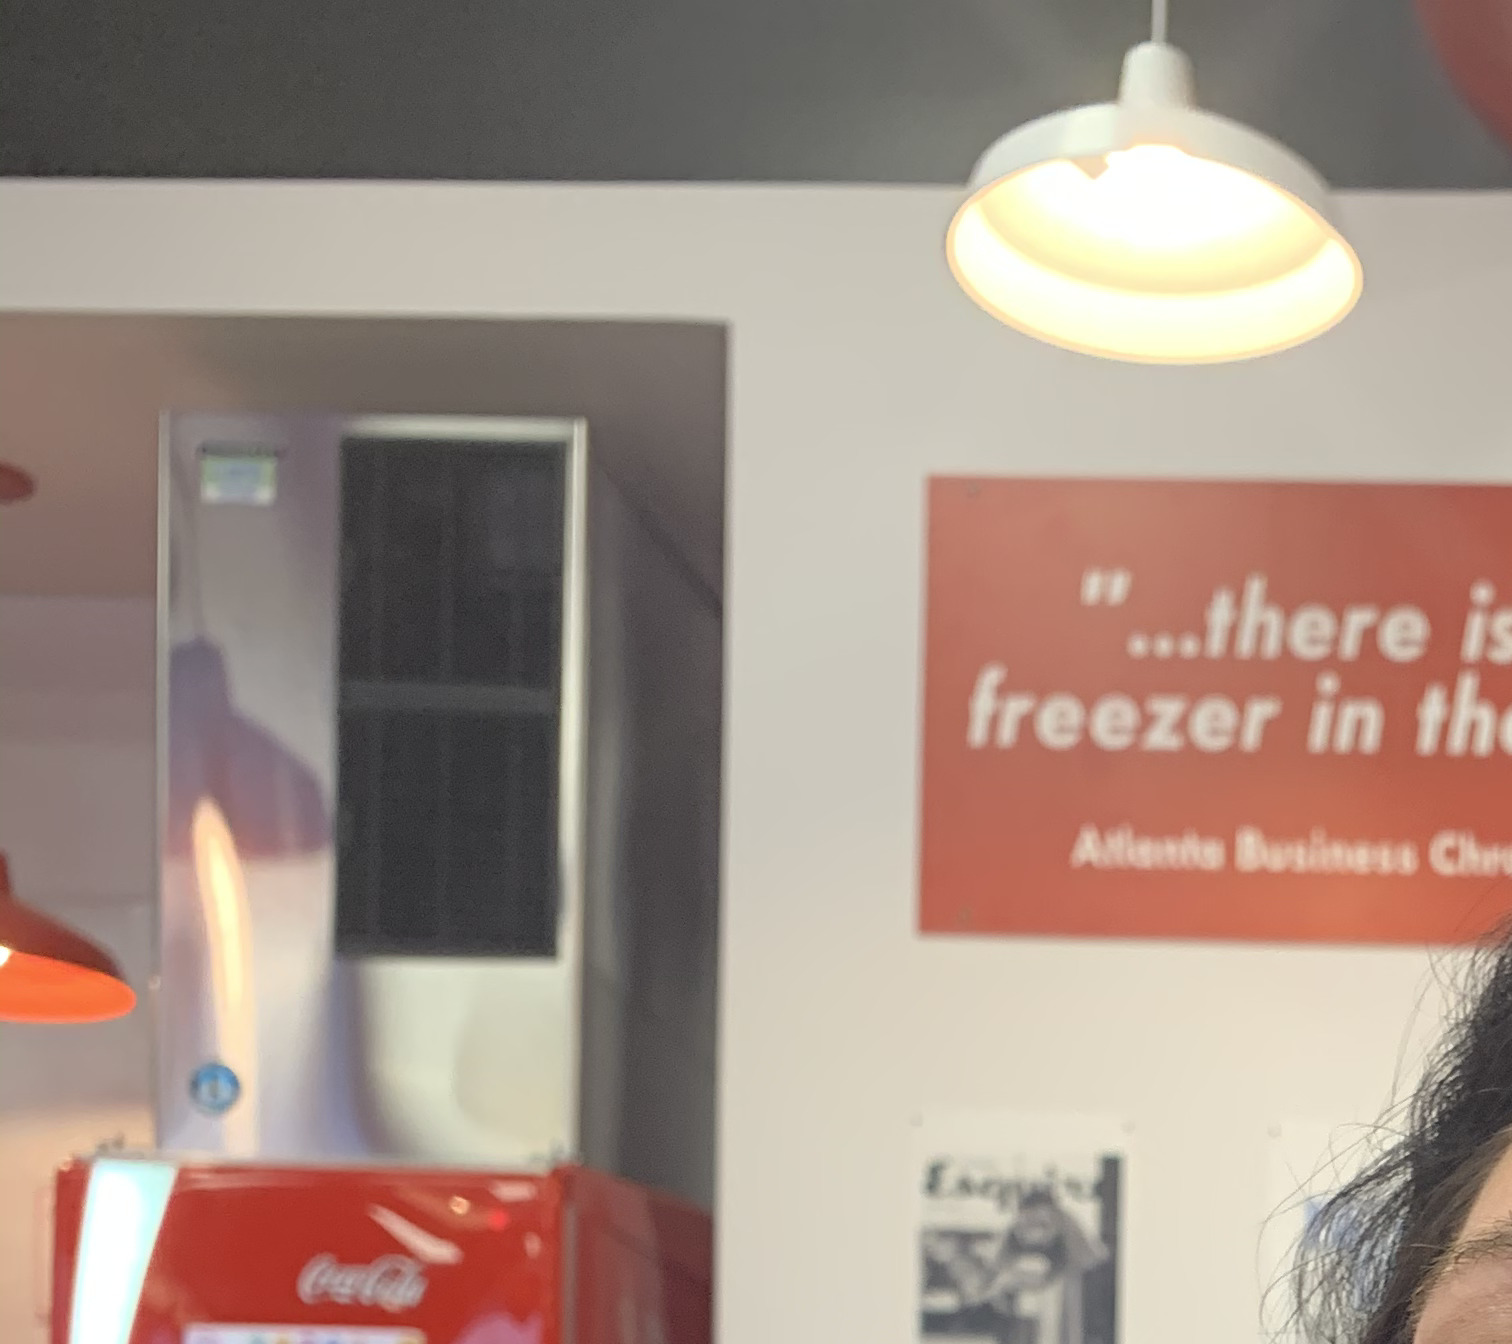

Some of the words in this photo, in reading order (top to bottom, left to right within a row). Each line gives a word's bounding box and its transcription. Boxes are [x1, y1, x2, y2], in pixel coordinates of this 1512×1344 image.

[966, 663, 1280, 751] freezer
[1307, 673, 1384, 755] in
[1070, 823, 1226, 870] Atlanta
[1234, 825, 1419, 876] Business
